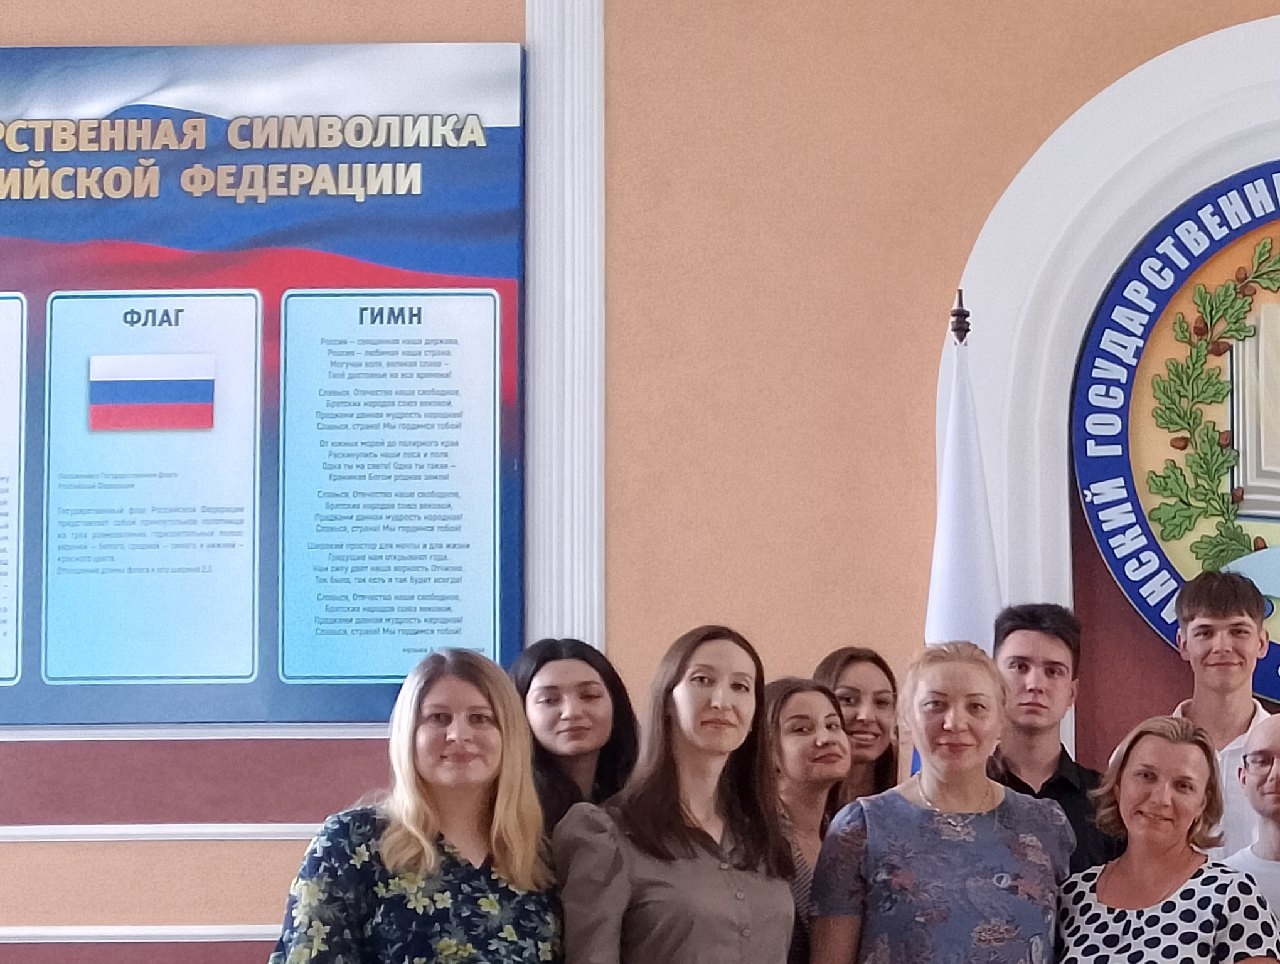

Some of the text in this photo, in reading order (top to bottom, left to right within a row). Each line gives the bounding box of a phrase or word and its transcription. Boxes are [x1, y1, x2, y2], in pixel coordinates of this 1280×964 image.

[0, 113, 487, 153] СТВЕННАЯ СИМВОЛИКА
[180, 162, 422, 203] ФЕДЕРАЦИИ
[122, 308, 184, 327] ФЛАГ
[358, 306, 423, 326] ГИМН
